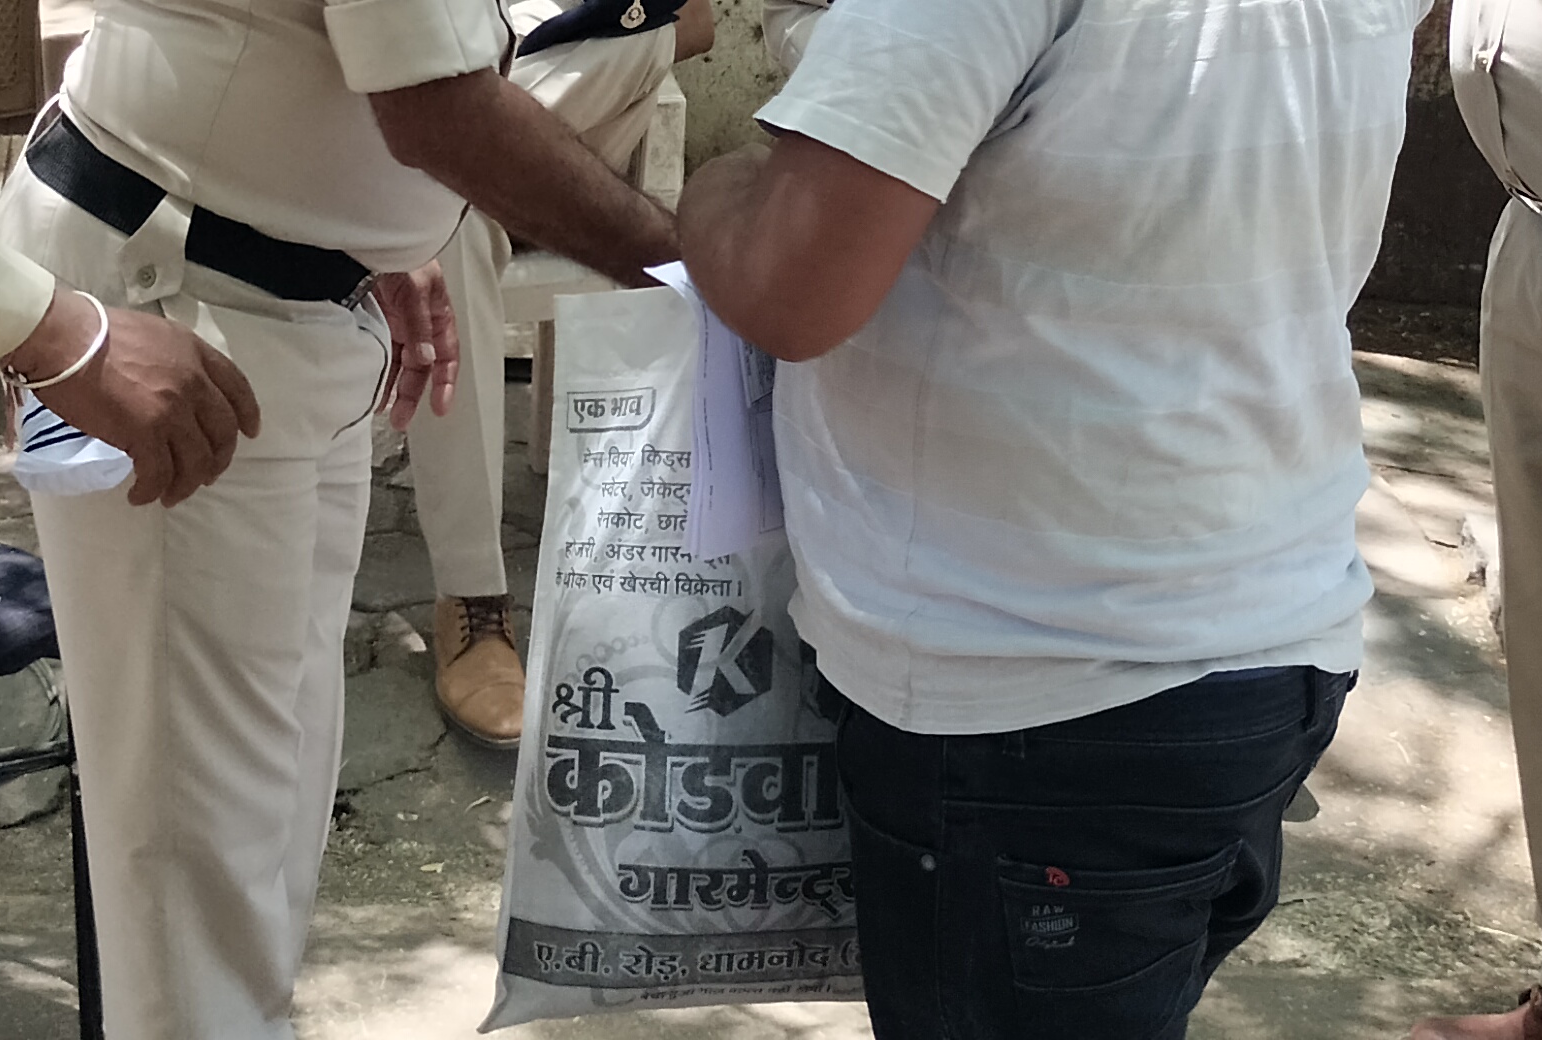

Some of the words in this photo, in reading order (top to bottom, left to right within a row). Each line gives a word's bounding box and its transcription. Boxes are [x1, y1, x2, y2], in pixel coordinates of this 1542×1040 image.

[573, 397, 606, 423] एक
[610, 395, 644, 418] भाव
[641, 443, 691, 473] किड्स
[606, 537, 646, 561] अंडर
[592, 568, 615, 594] एवं
[620, 570, 669, 595] खेरची
[552, 666, 619, 730] श्री
[535, 941, 611, 975] ए.बी.
[697, 939, 834, 976] धामनोद
